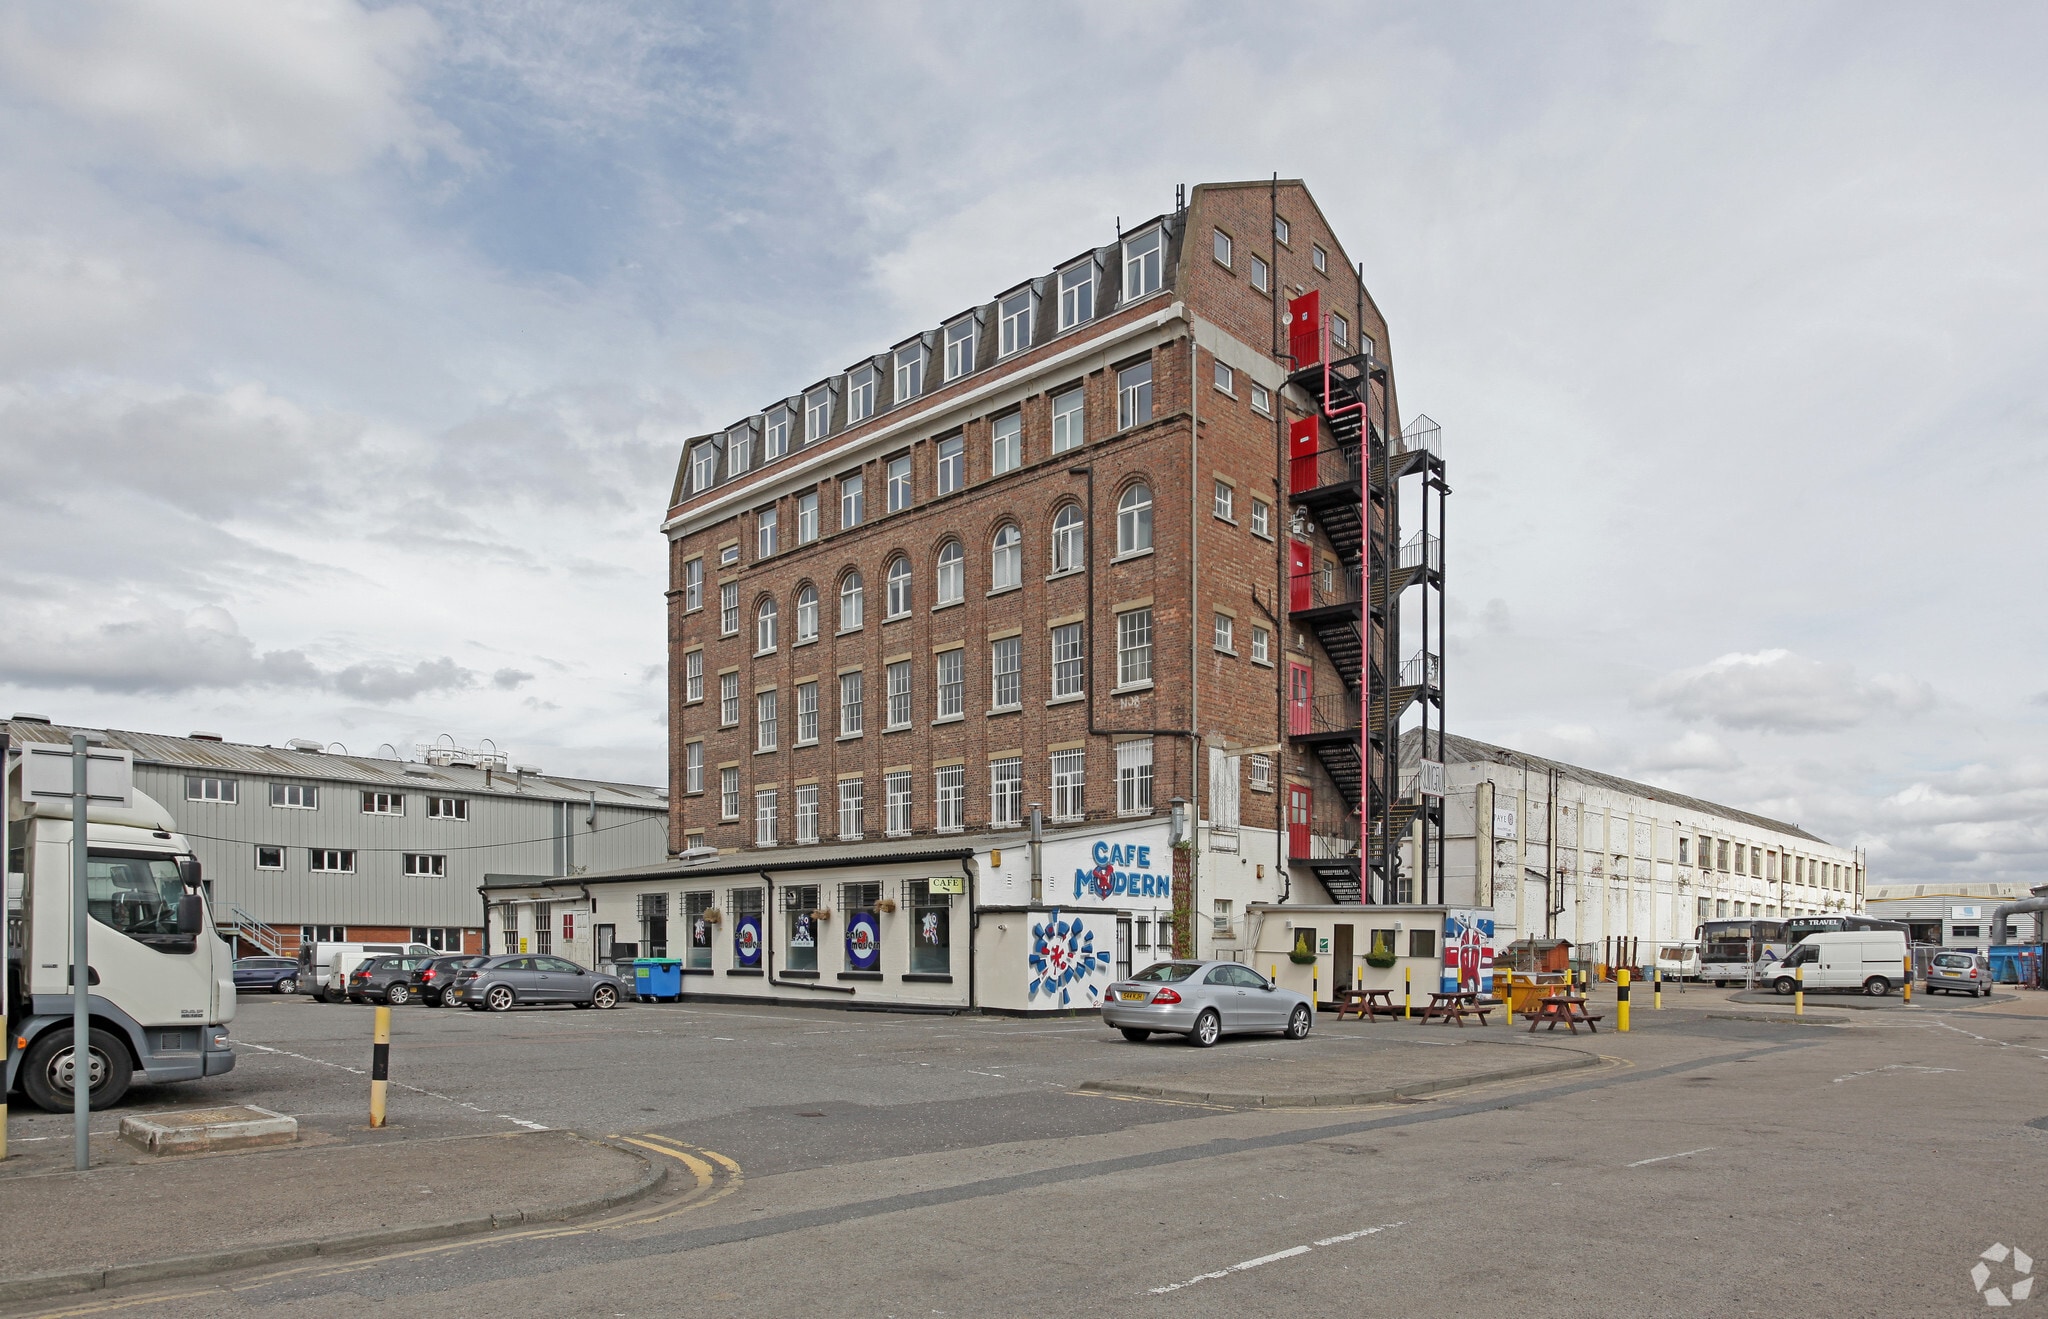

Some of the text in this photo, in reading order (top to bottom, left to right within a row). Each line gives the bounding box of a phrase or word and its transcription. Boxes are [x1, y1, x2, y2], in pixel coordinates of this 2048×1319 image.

[1092, 840, 1151, 869] CAFE
[933, 879, 959, 887] CAFE
[1073, 867, 1170, 901] MODERN
[734, 930, 748, 939] cafe
[845, 929, 863, 939] cafe
[851, 935, 880, 950] modern
